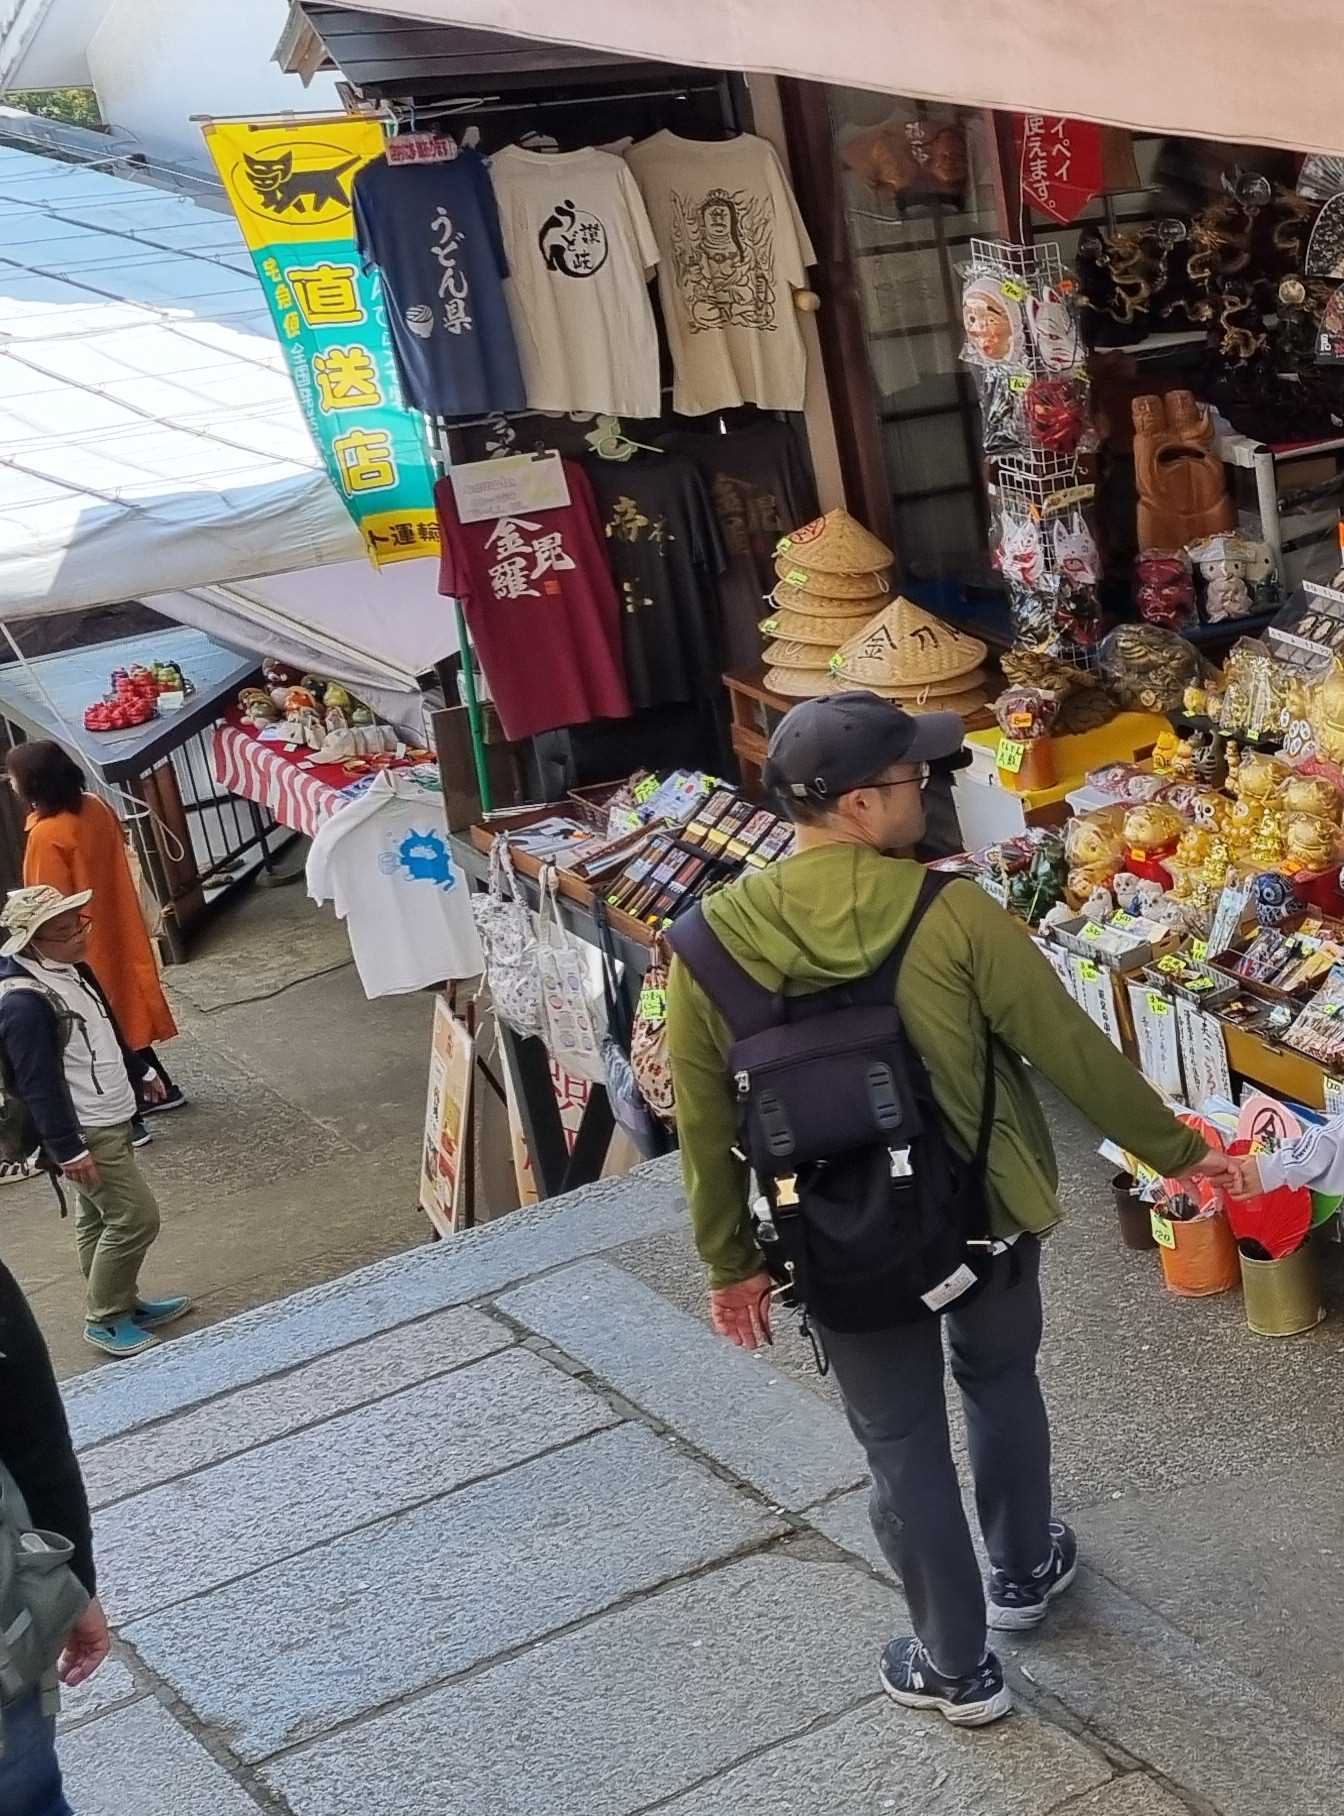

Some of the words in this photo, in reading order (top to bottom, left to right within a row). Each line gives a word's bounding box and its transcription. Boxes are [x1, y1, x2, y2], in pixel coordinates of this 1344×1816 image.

[431, 206, 473, 335] うどん県
[286, 264, 397, 498] 直送店
